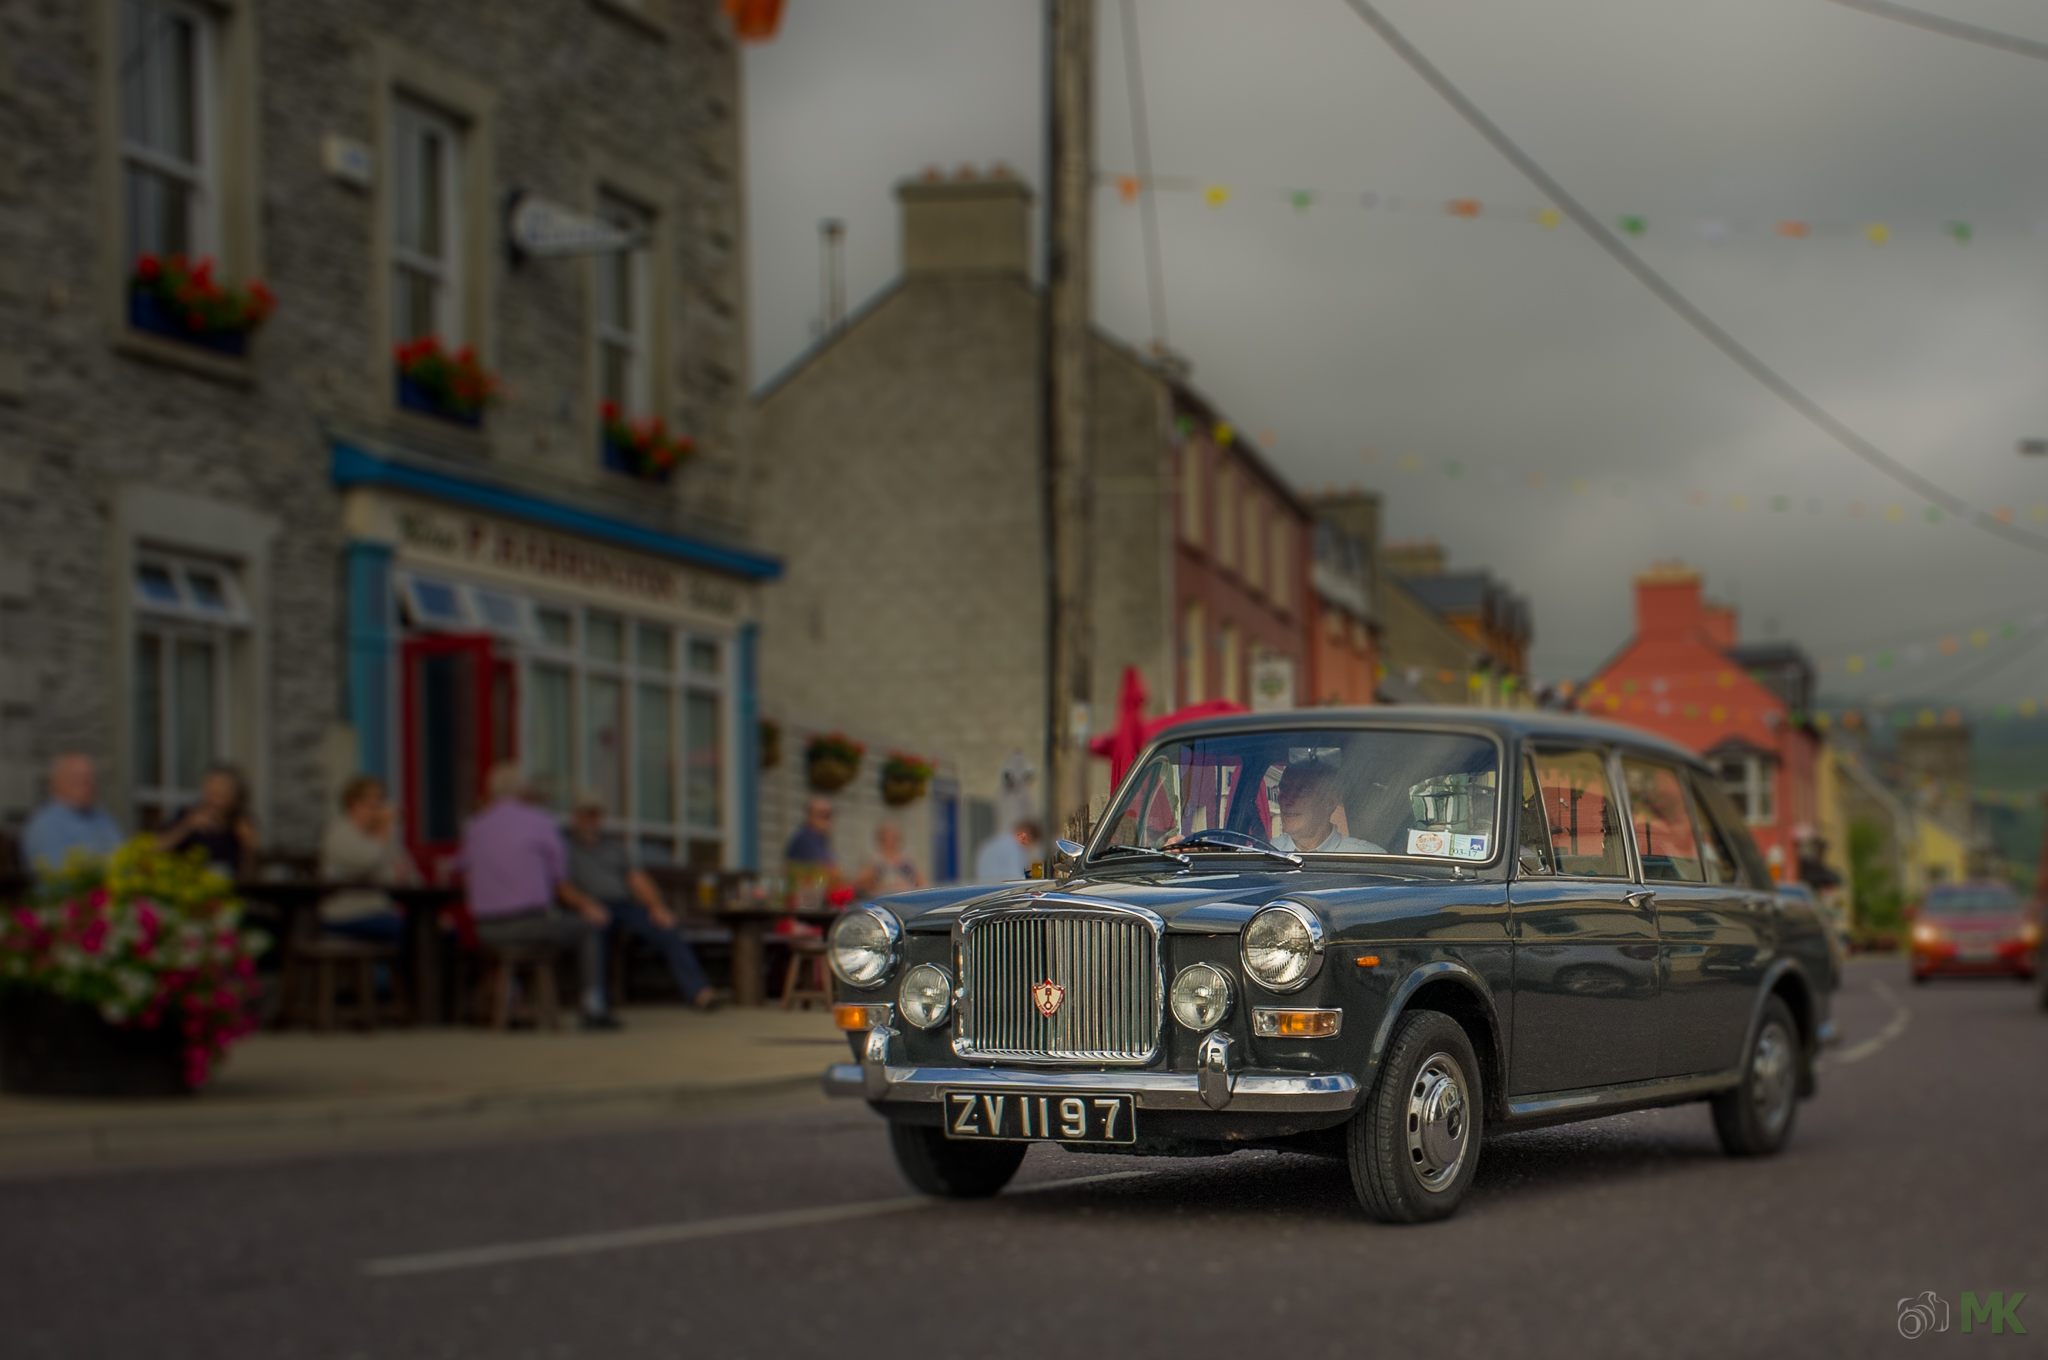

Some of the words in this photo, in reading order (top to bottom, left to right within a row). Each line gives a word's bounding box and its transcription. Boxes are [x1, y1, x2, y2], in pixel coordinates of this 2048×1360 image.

[1453, 848, 1478, 857] 03-17
[952, 1095, 1005, 1135] ZV
[1020, 1096, 1120, 1138] 1197
